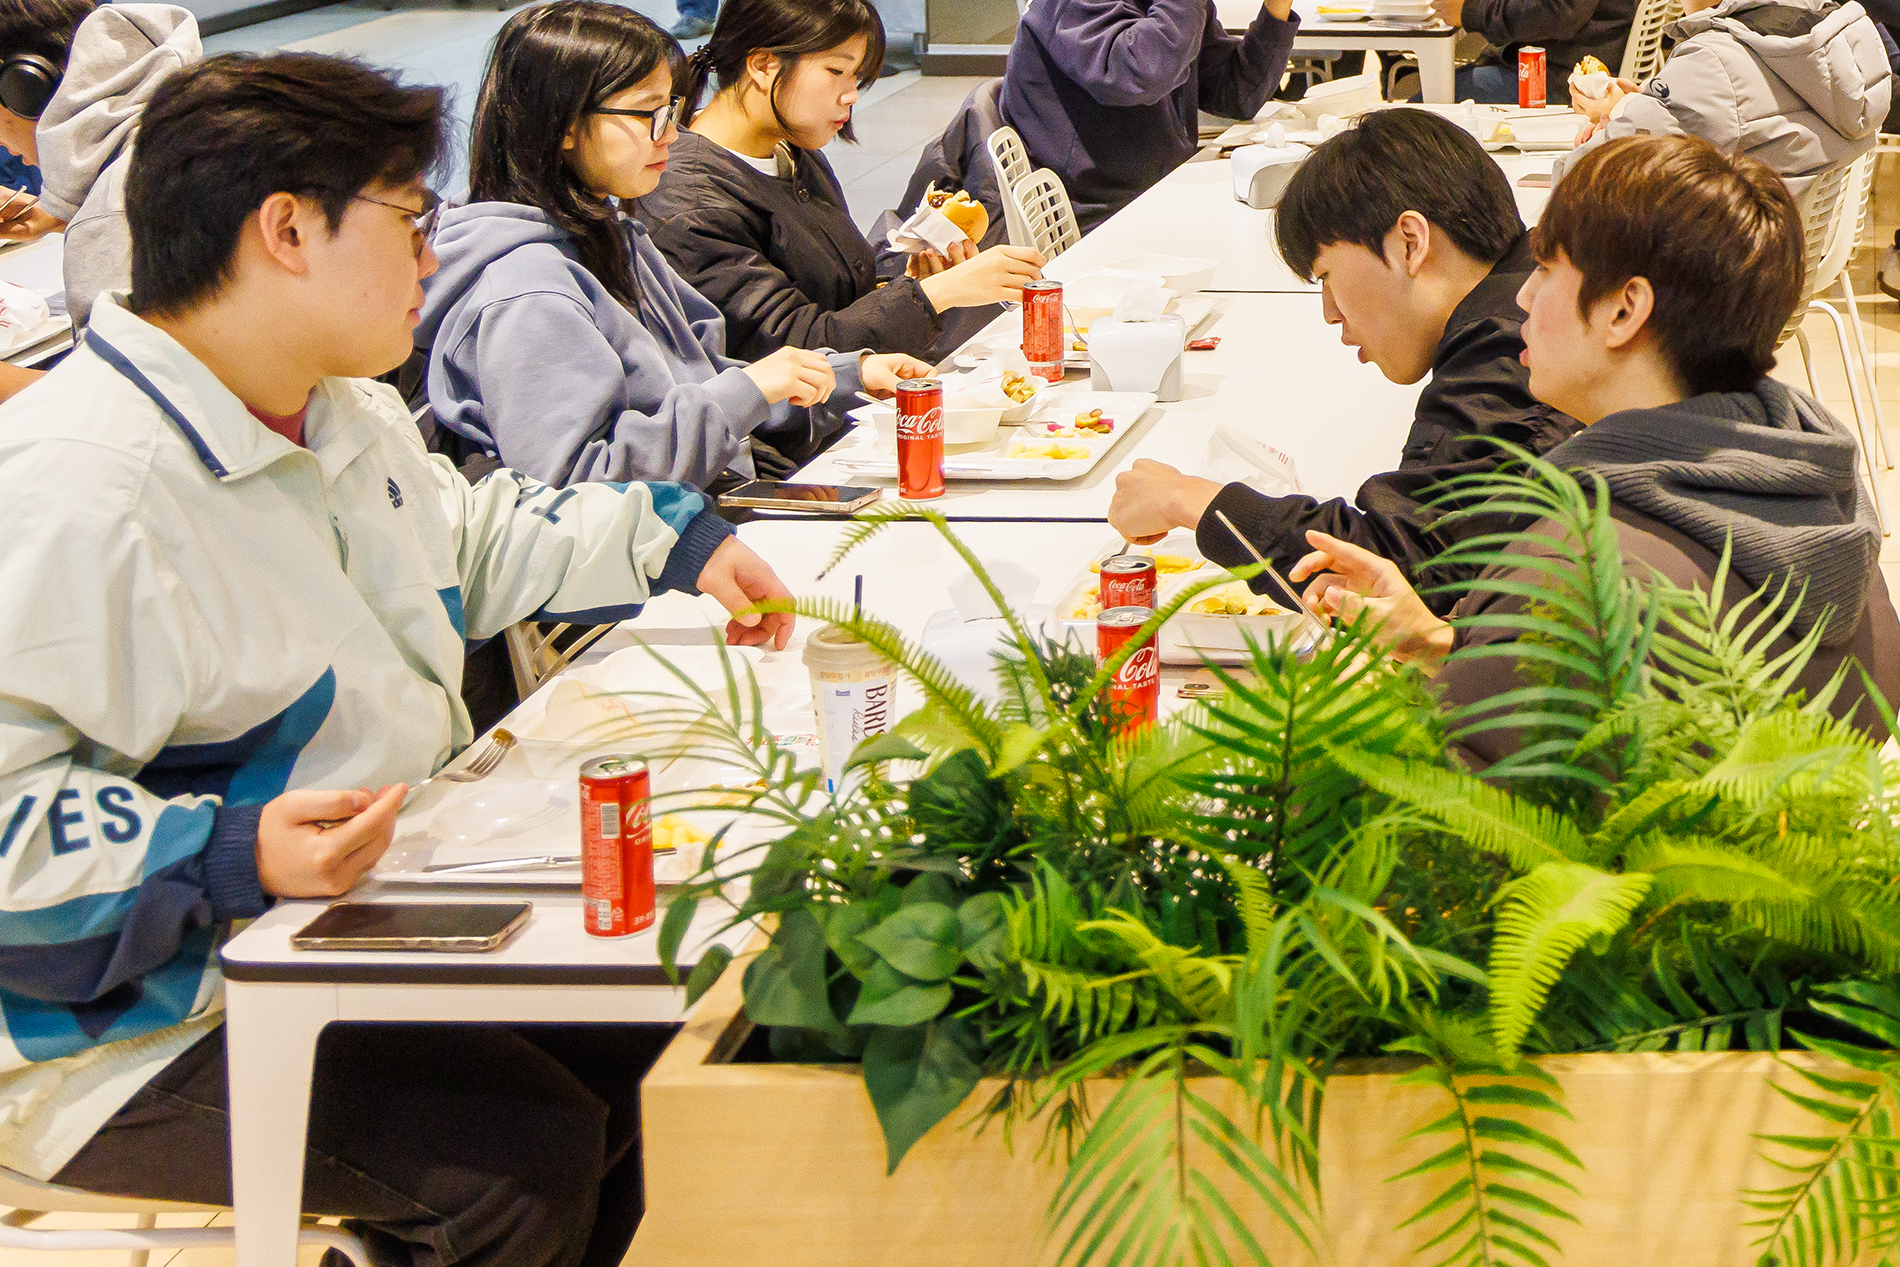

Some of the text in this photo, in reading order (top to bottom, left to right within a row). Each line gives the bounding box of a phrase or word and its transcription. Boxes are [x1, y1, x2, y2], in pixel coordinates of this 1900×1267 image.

[1032, 292, 1060, 303] Coca-Cola
[1108, 577, 1146, 592] Coca-Cola
[1132, 678, 1155, 690] TASTE
